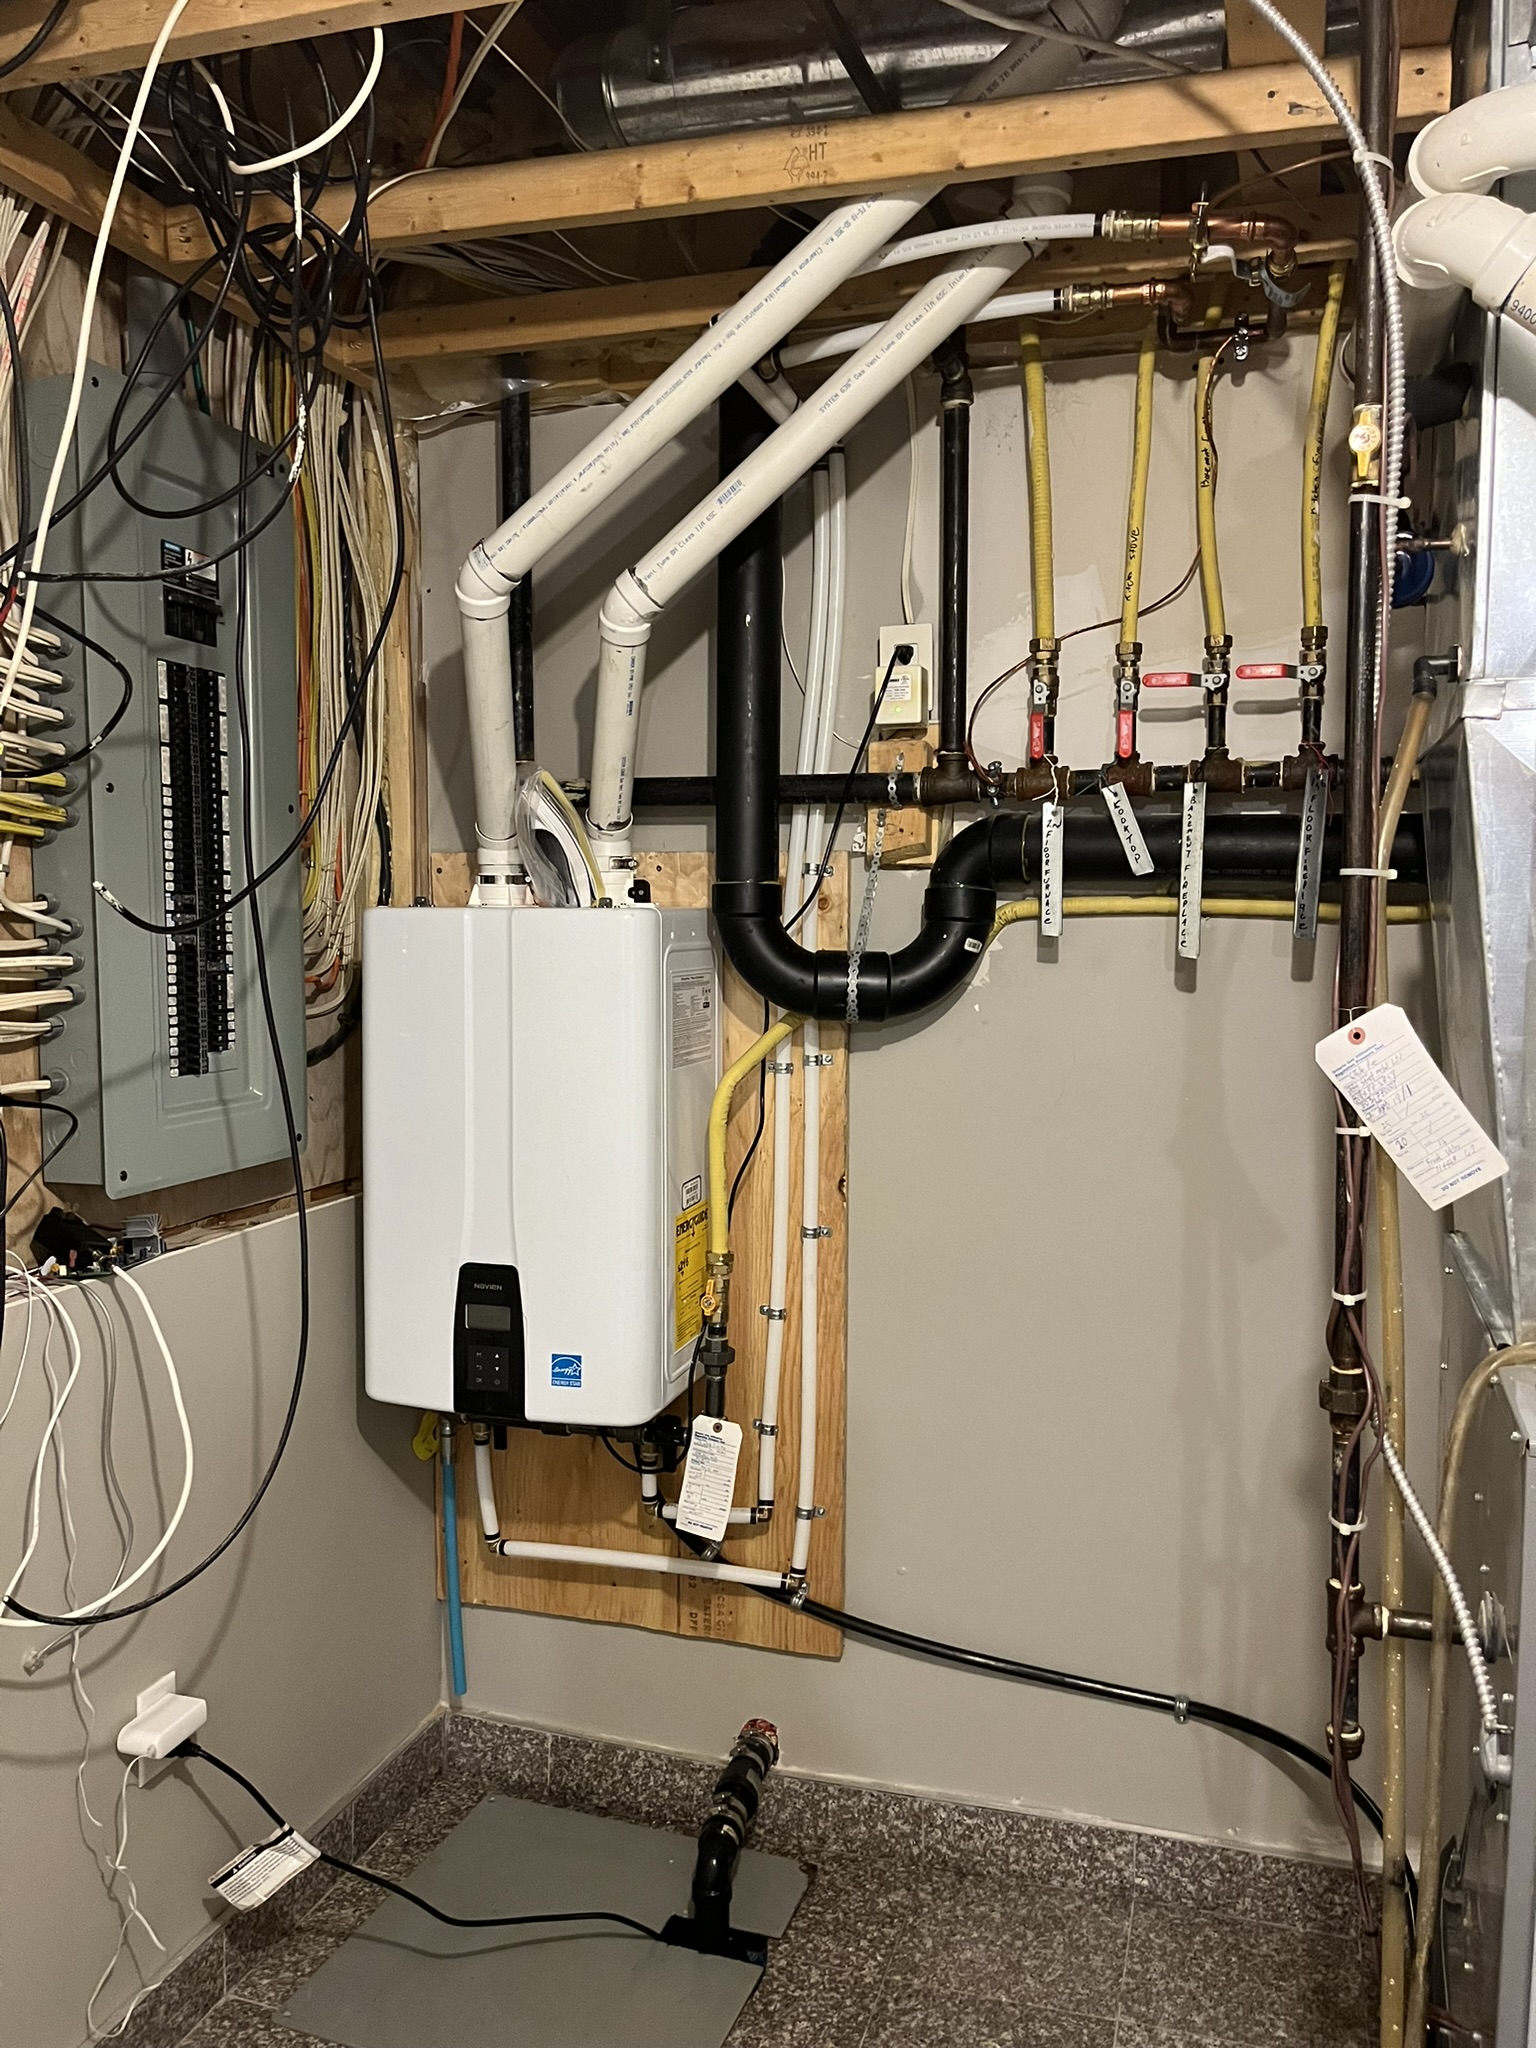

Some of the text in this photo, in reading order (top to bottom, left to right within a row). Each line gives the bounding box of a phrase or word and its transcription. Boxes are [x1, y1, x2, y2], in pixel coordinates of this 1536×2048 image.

[809, 142, 827, 161] HT
[797, 246, 823, 271] Clearance
[790, 269, 799, 278] to
[762, 275, 792, 304] combustible
[733, 301, 765, 331] construction
[818, 392, 839, 413] SYSTEM
[852, 367, 866, 380] Gas
[865, 353, 880, 368] Vent
[880, 339, 896, 354] Type
[904, 312, 923, 331] Class
[653, 377, 683, 406] construction
[628, 403, 656, 429] combustible
[602, 438, 618, 454] Follow
[546, 480, 574, 507] installation
[521, 504, 549, 530] requirements
[642, 568, 656, 581] Vent
[657, 554, 671, 568] Type
[677, 531, 695, 548] Class
[1305, 795, 1316, 842] FLOOR
[1442, 1167, 1482, 1192] DO NOT REMOVE
[689, 1612, 698, 1632] DFP
